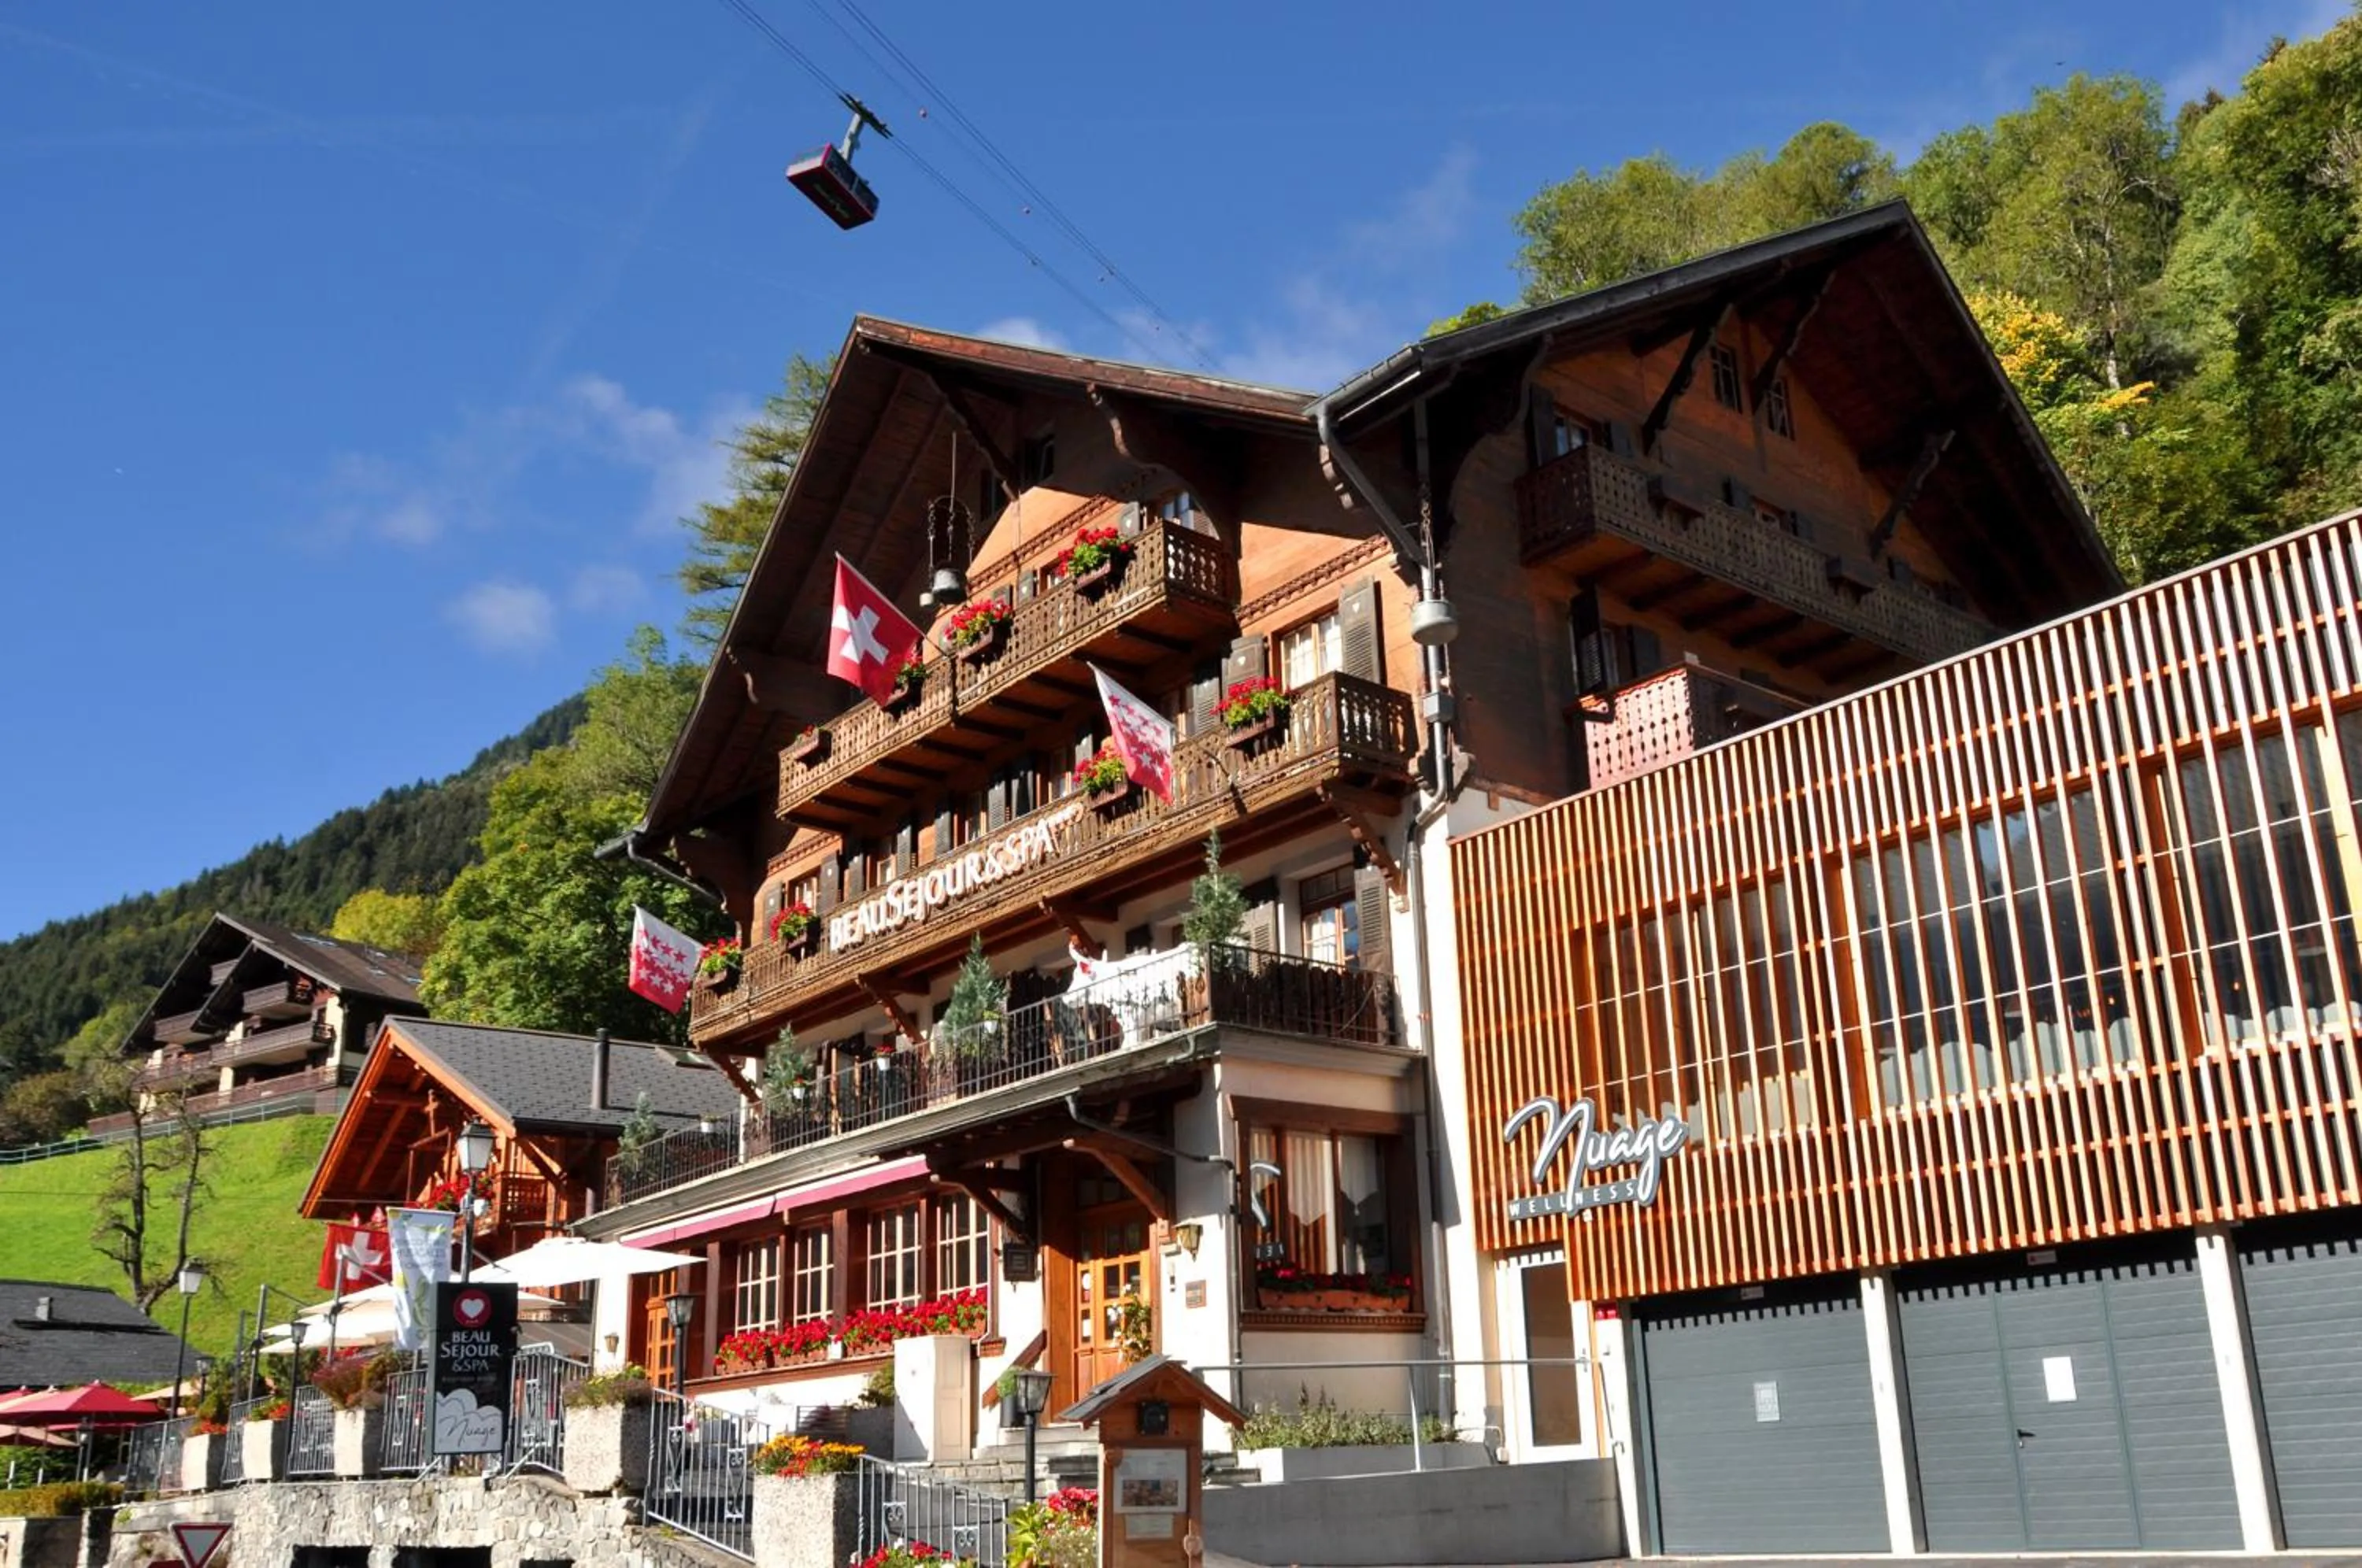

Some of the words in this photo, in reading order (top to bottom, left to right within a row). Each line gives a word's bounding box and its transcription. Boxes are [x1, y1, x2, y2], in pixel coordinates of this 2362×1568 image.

[1504, 1097, 1685, 1213] Nuage
[1509, 1181, 1635, 1217] WELLNESS
[440, 1341, 500, 1359] SEJOUR
[451, 1330, 491, 1344] BEAU
[438, 1416, 497, 1447] Nuage
